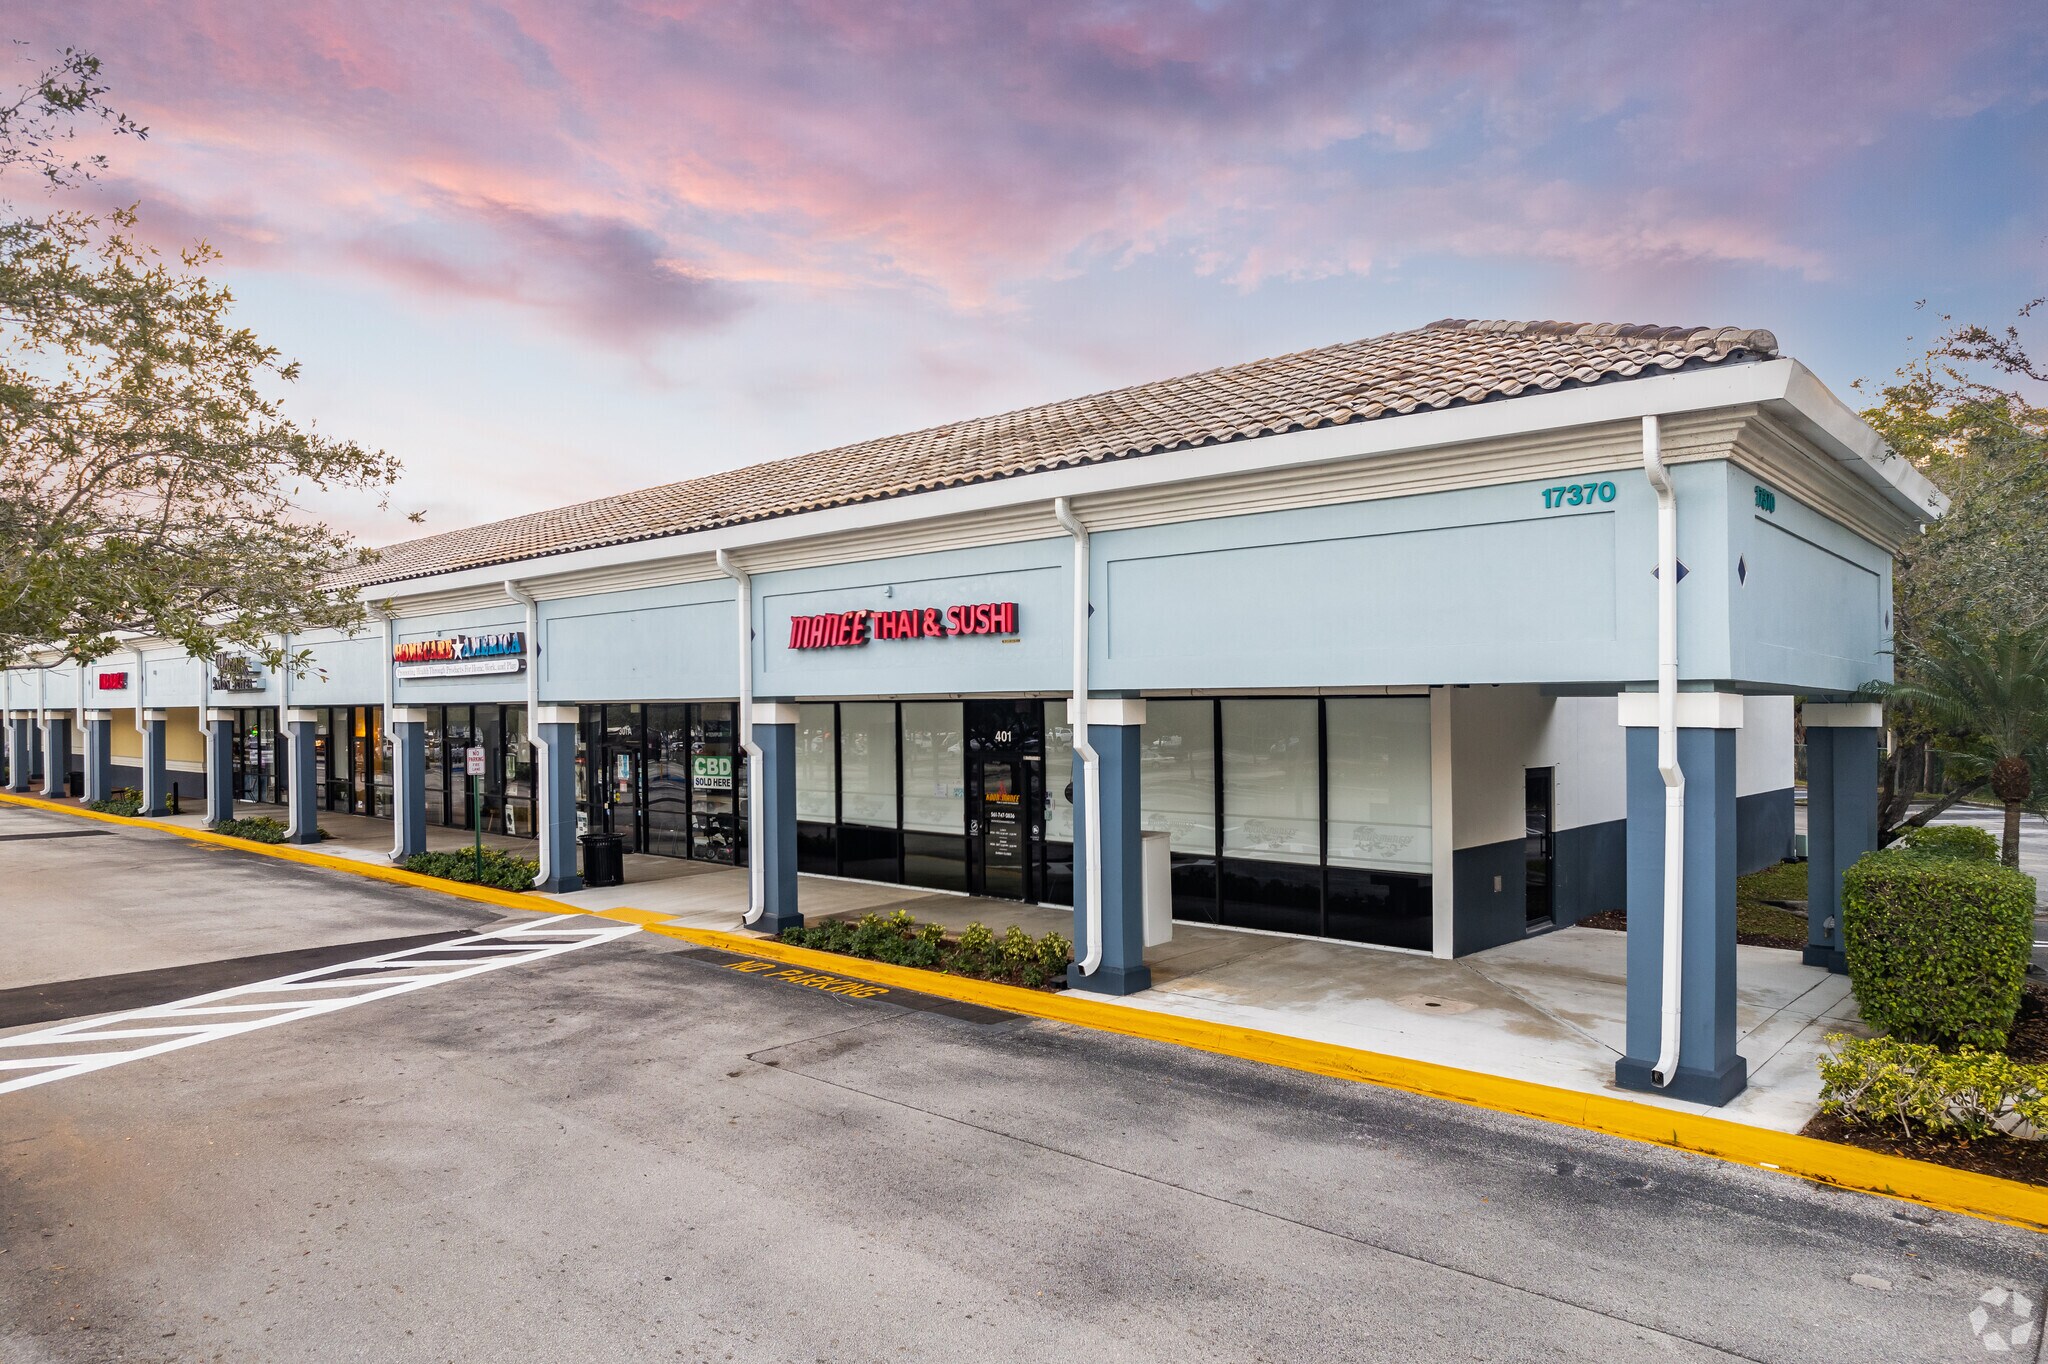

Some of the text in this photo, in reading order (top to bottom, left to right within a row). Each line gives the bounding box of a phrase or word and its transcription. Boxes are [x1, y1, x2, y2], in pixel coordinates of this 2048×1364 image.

[1541, 481, 1616, 508] 17370
[788, 602, 1016, 649] MANEE THAI & SUSHI
[394, 632, 523, 662] HOMECARE AMERICA
[995, 731, 1012, 742] 401
[694, 757, 732, 776] CBD
[695, 777, 731, 787] SOLD HERE
[722, 960, 890, 998] NO PARKING
